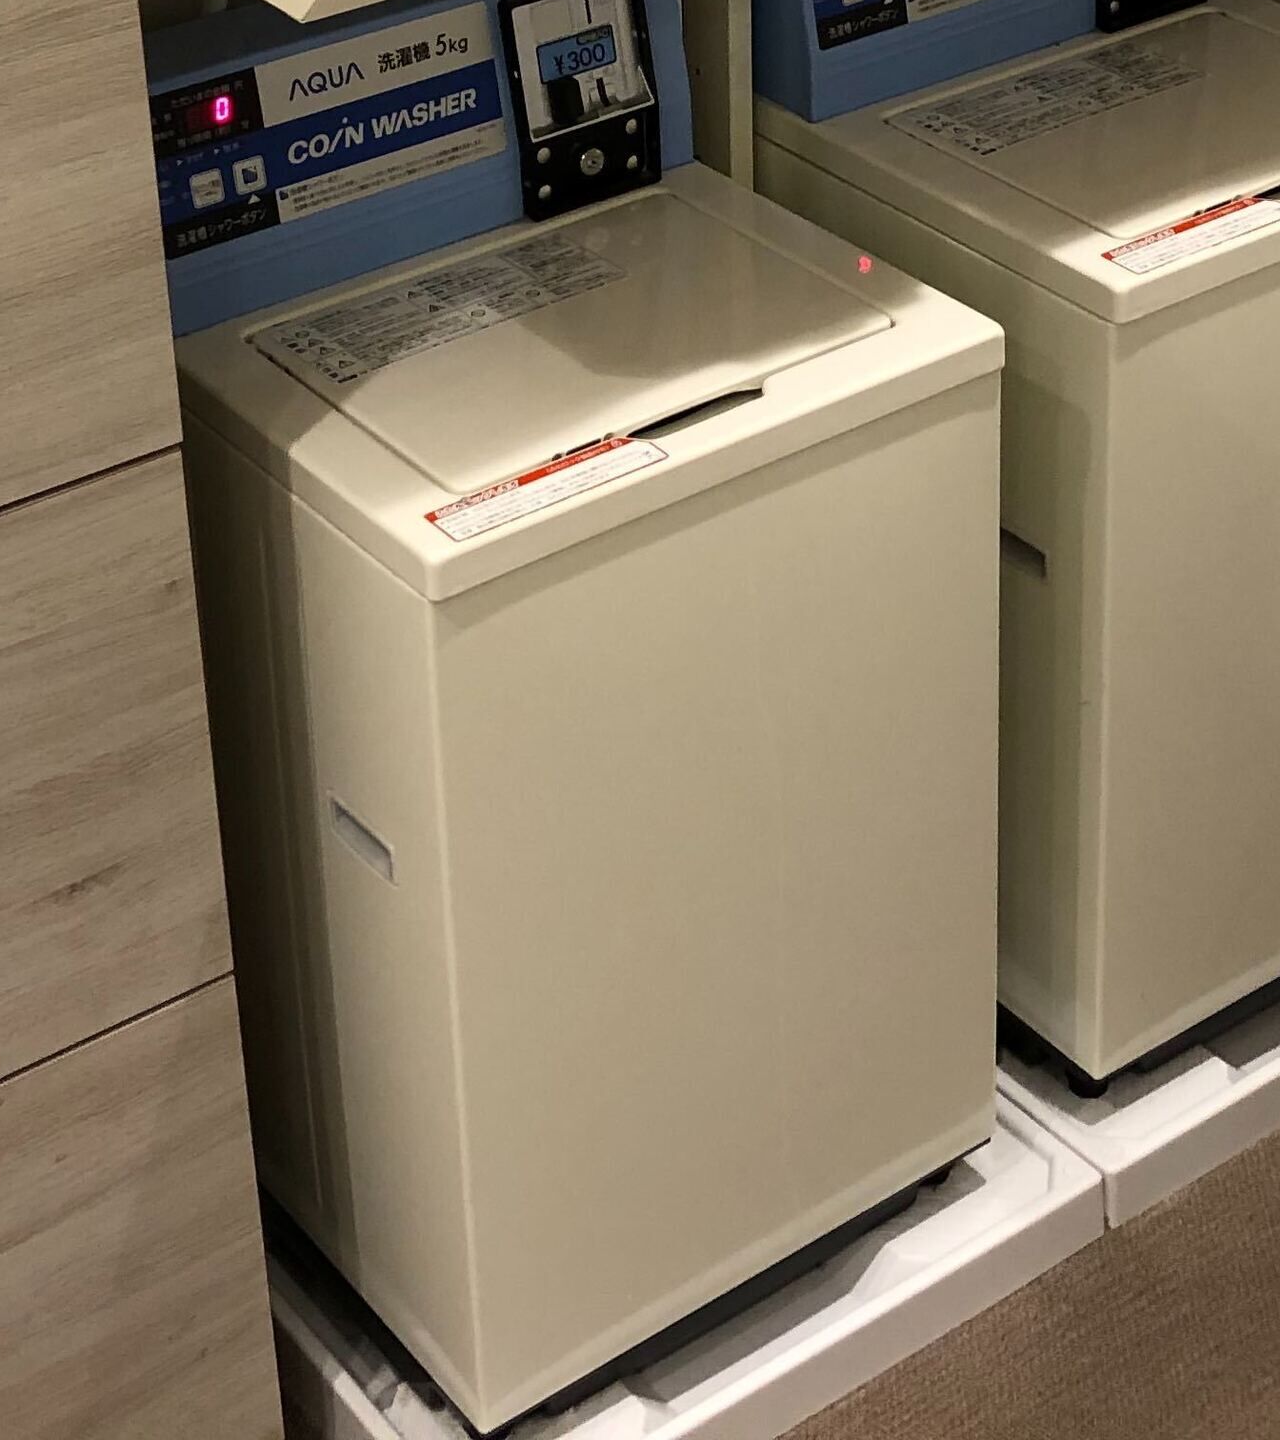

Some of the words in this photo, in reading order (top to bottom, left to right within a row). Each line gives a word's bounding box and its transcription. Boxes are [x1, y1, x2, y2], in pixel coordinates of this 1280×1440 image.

[289, 62, 364, 101] AQUA
[377, 41, 431, 74] 洗濯機
[435, 33, 469, 56] 5kg
[554, 43, 606, 76] ¥300
[215, 96, 230, 121] 0
[371, 87, 478, 139] WASHER
